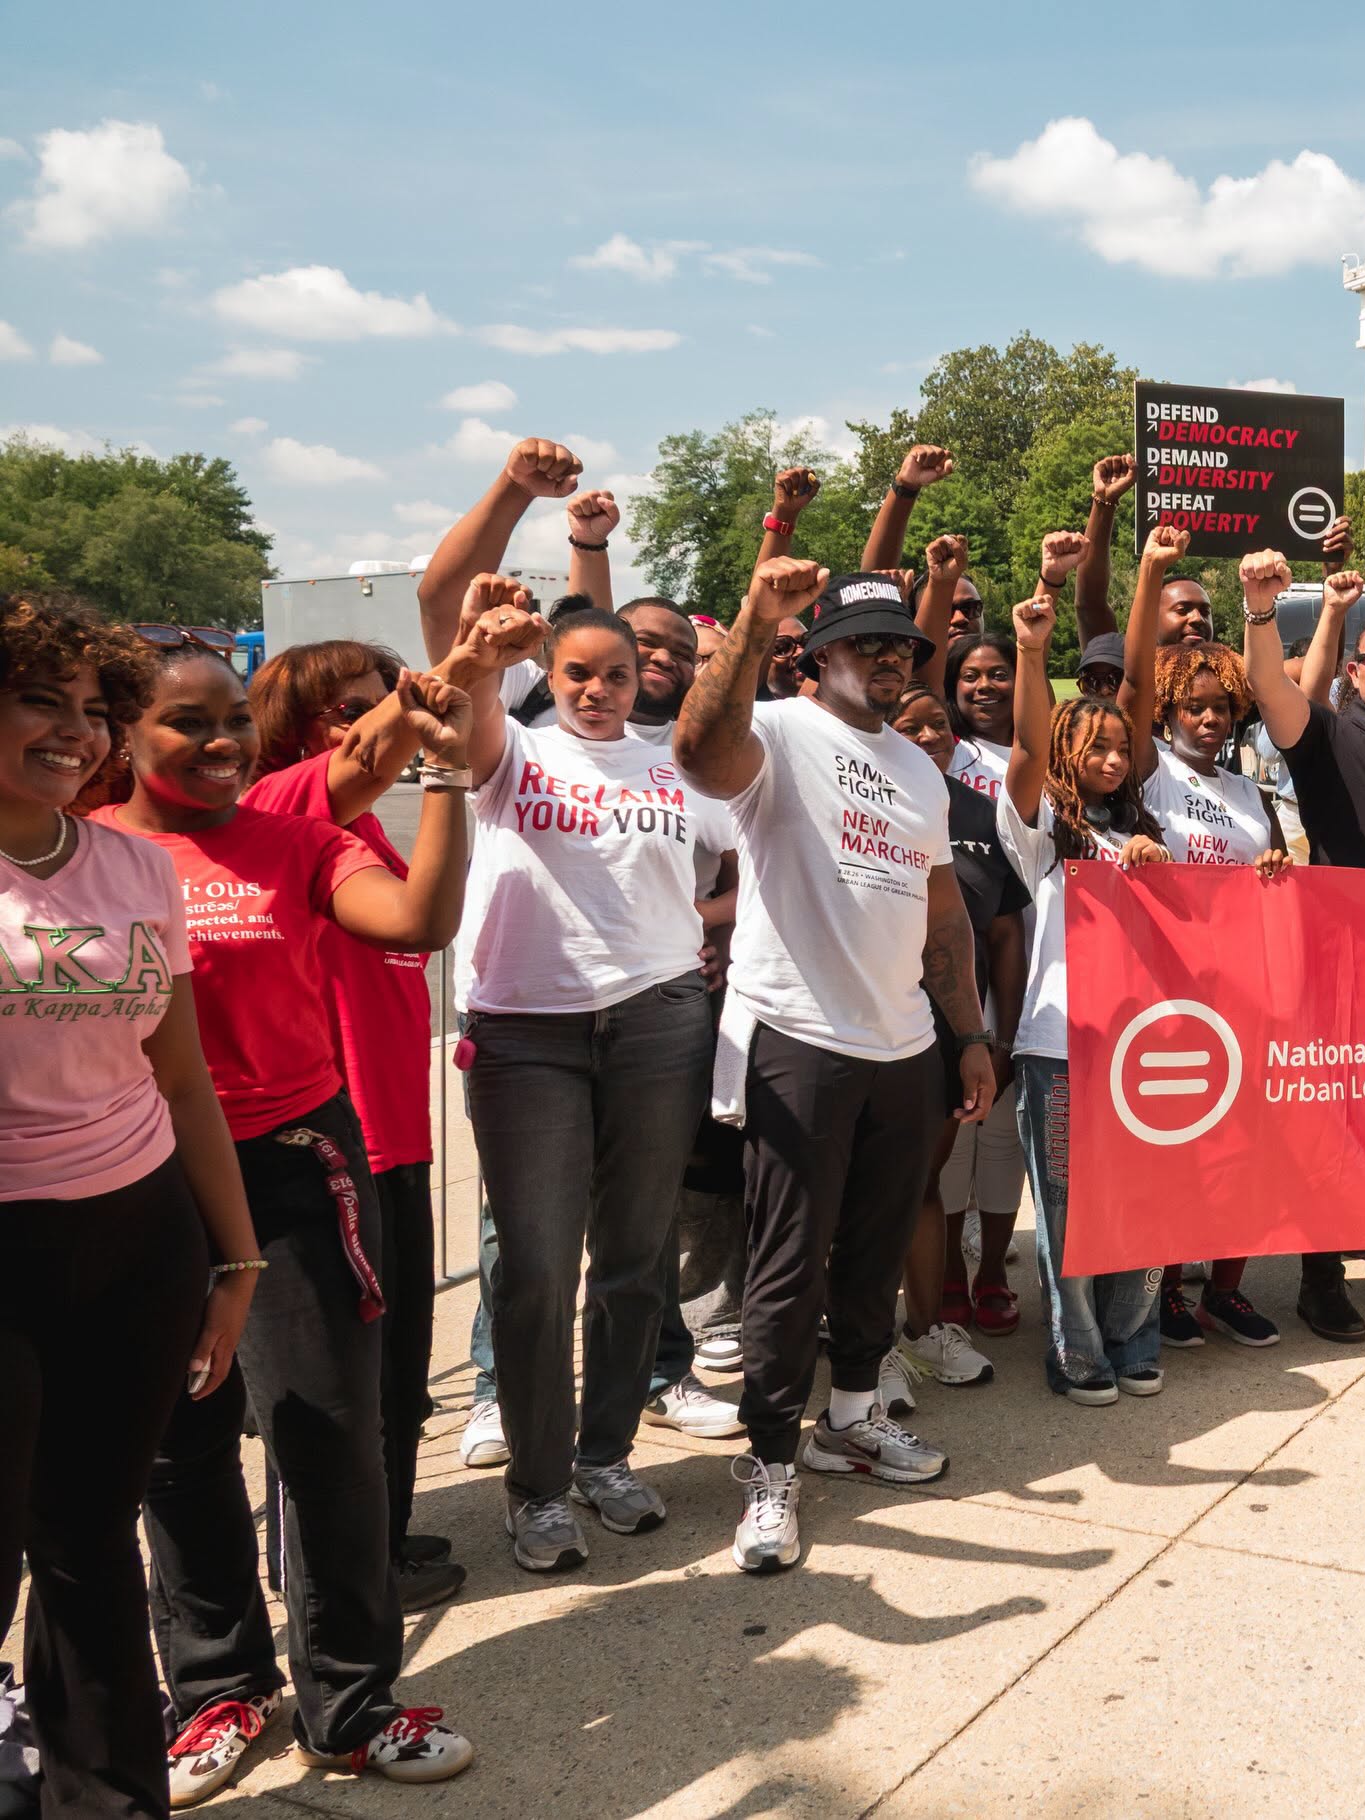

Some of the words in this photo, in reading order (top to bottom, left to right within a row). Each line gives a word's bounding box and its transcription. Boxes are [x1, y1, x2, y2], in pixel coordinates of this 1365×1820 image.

[1146, 402, 1219, 423] DEFEND
[1158, 421, 1299, 449] DEMOCRACY
[1147, 447, 1229, 467] DEMAND
[1158, 466, 1274, 491] DIVERSITY
[1147, 492, 1214, 511] DEFEAT
[1159, 510, 1260, 534] POVERTY
[518, 761, 685, 813] RECLAIM
[514, 801, 600, 836] YOUR
[613, 807, 686, 844] VOTE
[843, 809, 890, 838] NEW
[1188, 833, 1228, 853] NEW
[837, 877, 859, 886] URBAN
[860, 881, 882, 891] LEAGUE
[891, 888, 911, 897] GREATER
[865, 873, 901, 887] WASHINGTON
[186, 914, 244, 929] pected,
[247, 913, 274, 924] and
[188, 929, 285, 942] chievements.
[24, 997, 103, 1022] Kappa
[101, 997, 161, 1021] Alpha
[1265, 1076, 1345, 1103] Urban
[343, 1196, 358, 1231] Delta
